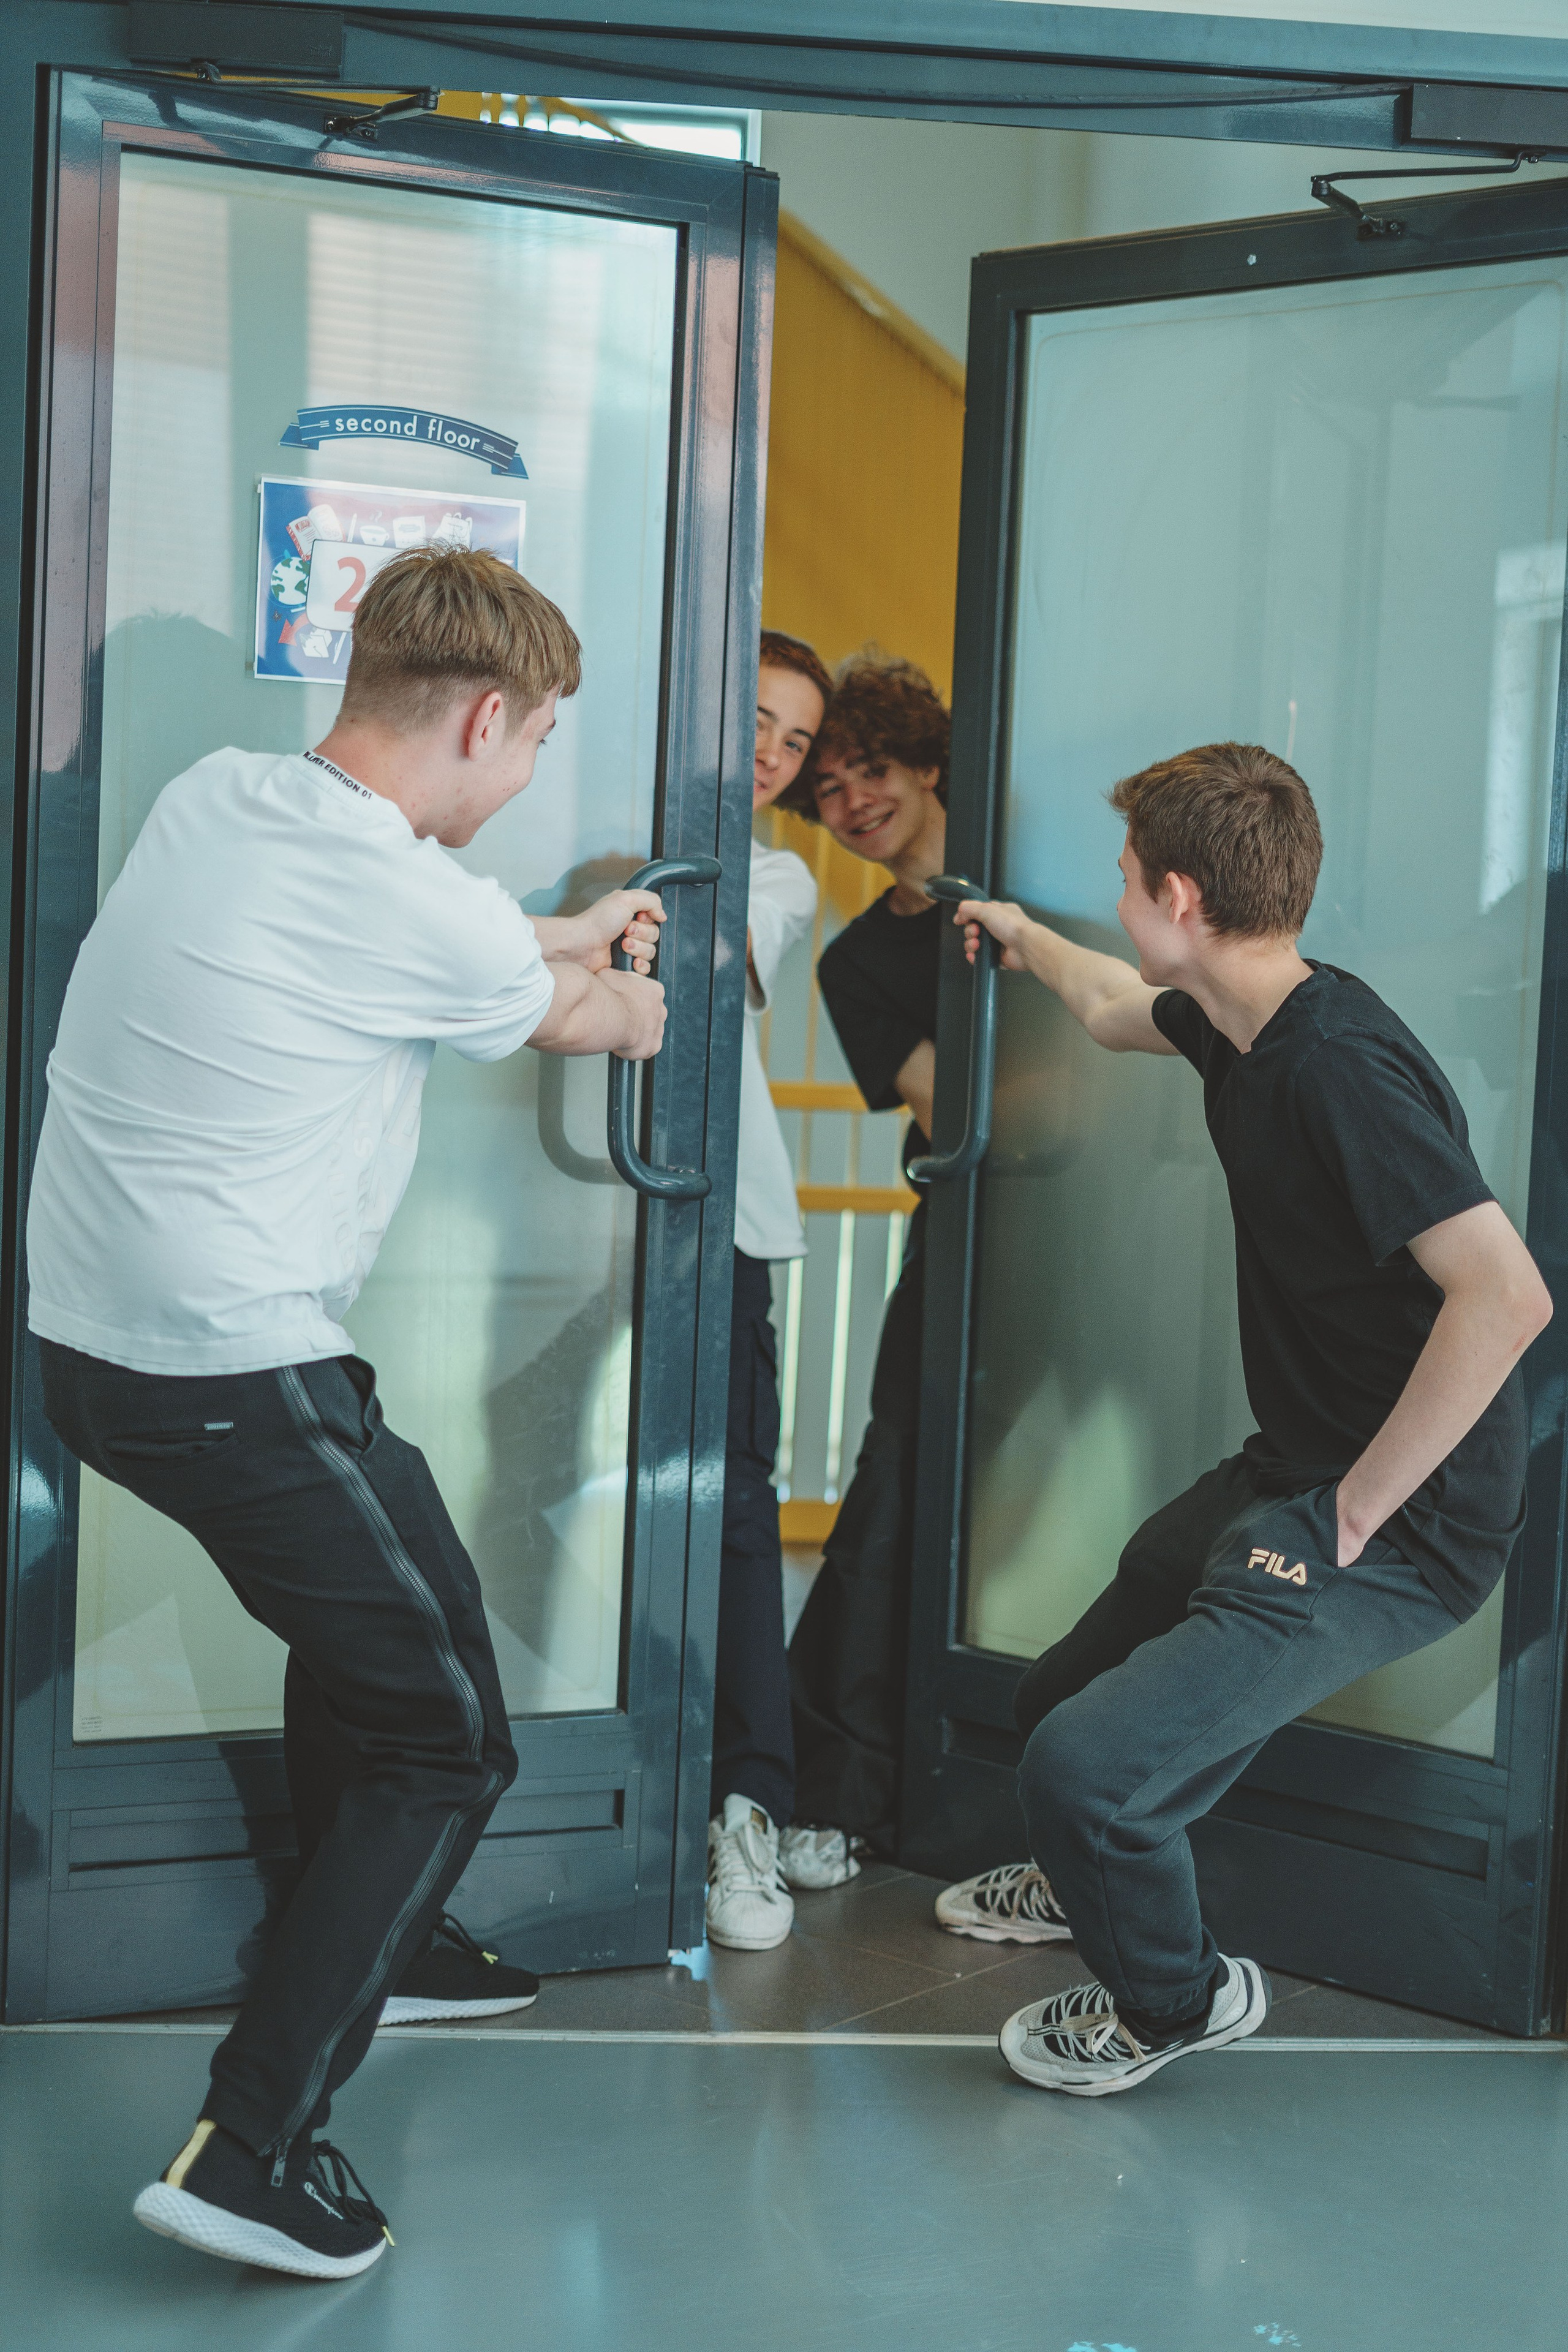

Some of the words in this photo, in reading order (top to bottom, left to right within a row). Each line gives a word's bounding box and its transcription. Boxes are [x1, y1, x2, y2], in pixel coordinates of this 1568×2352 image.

[335, 415, 418, 436] second
[428, 418, 480, 450] floor
[334, 556, 366, 612] 2
[324, 764, 361, 793] EDITION
[361, 790, 372, 800] 01
[1247, 1548, 1307, 1586] FILA
